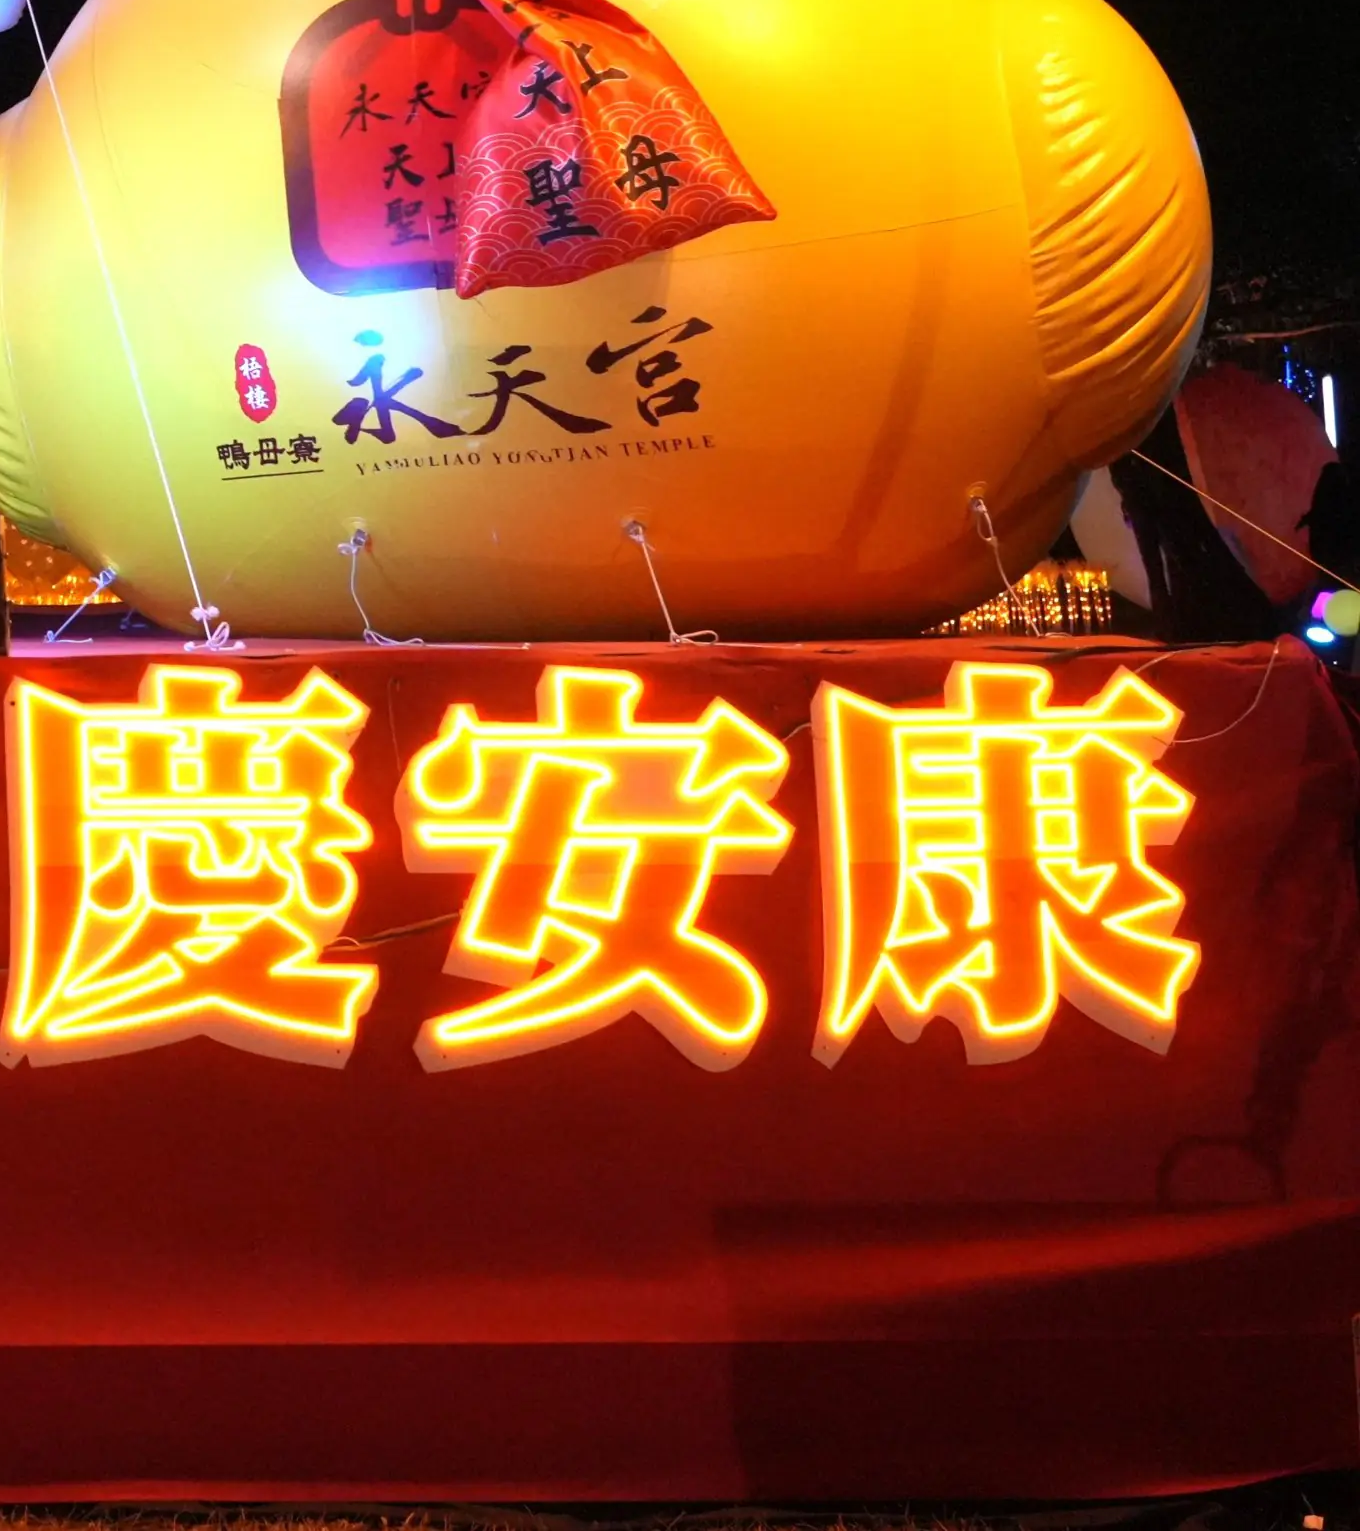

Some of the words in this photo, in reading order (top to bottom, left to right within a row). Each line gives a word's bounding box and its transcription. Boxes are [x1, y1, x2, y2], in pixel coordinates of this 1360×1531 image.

[239, 356, 271, 410] 梧棲
[332, 305, 714, 445] 永天宮
[619, 434, 716, 458] TEMPLE
